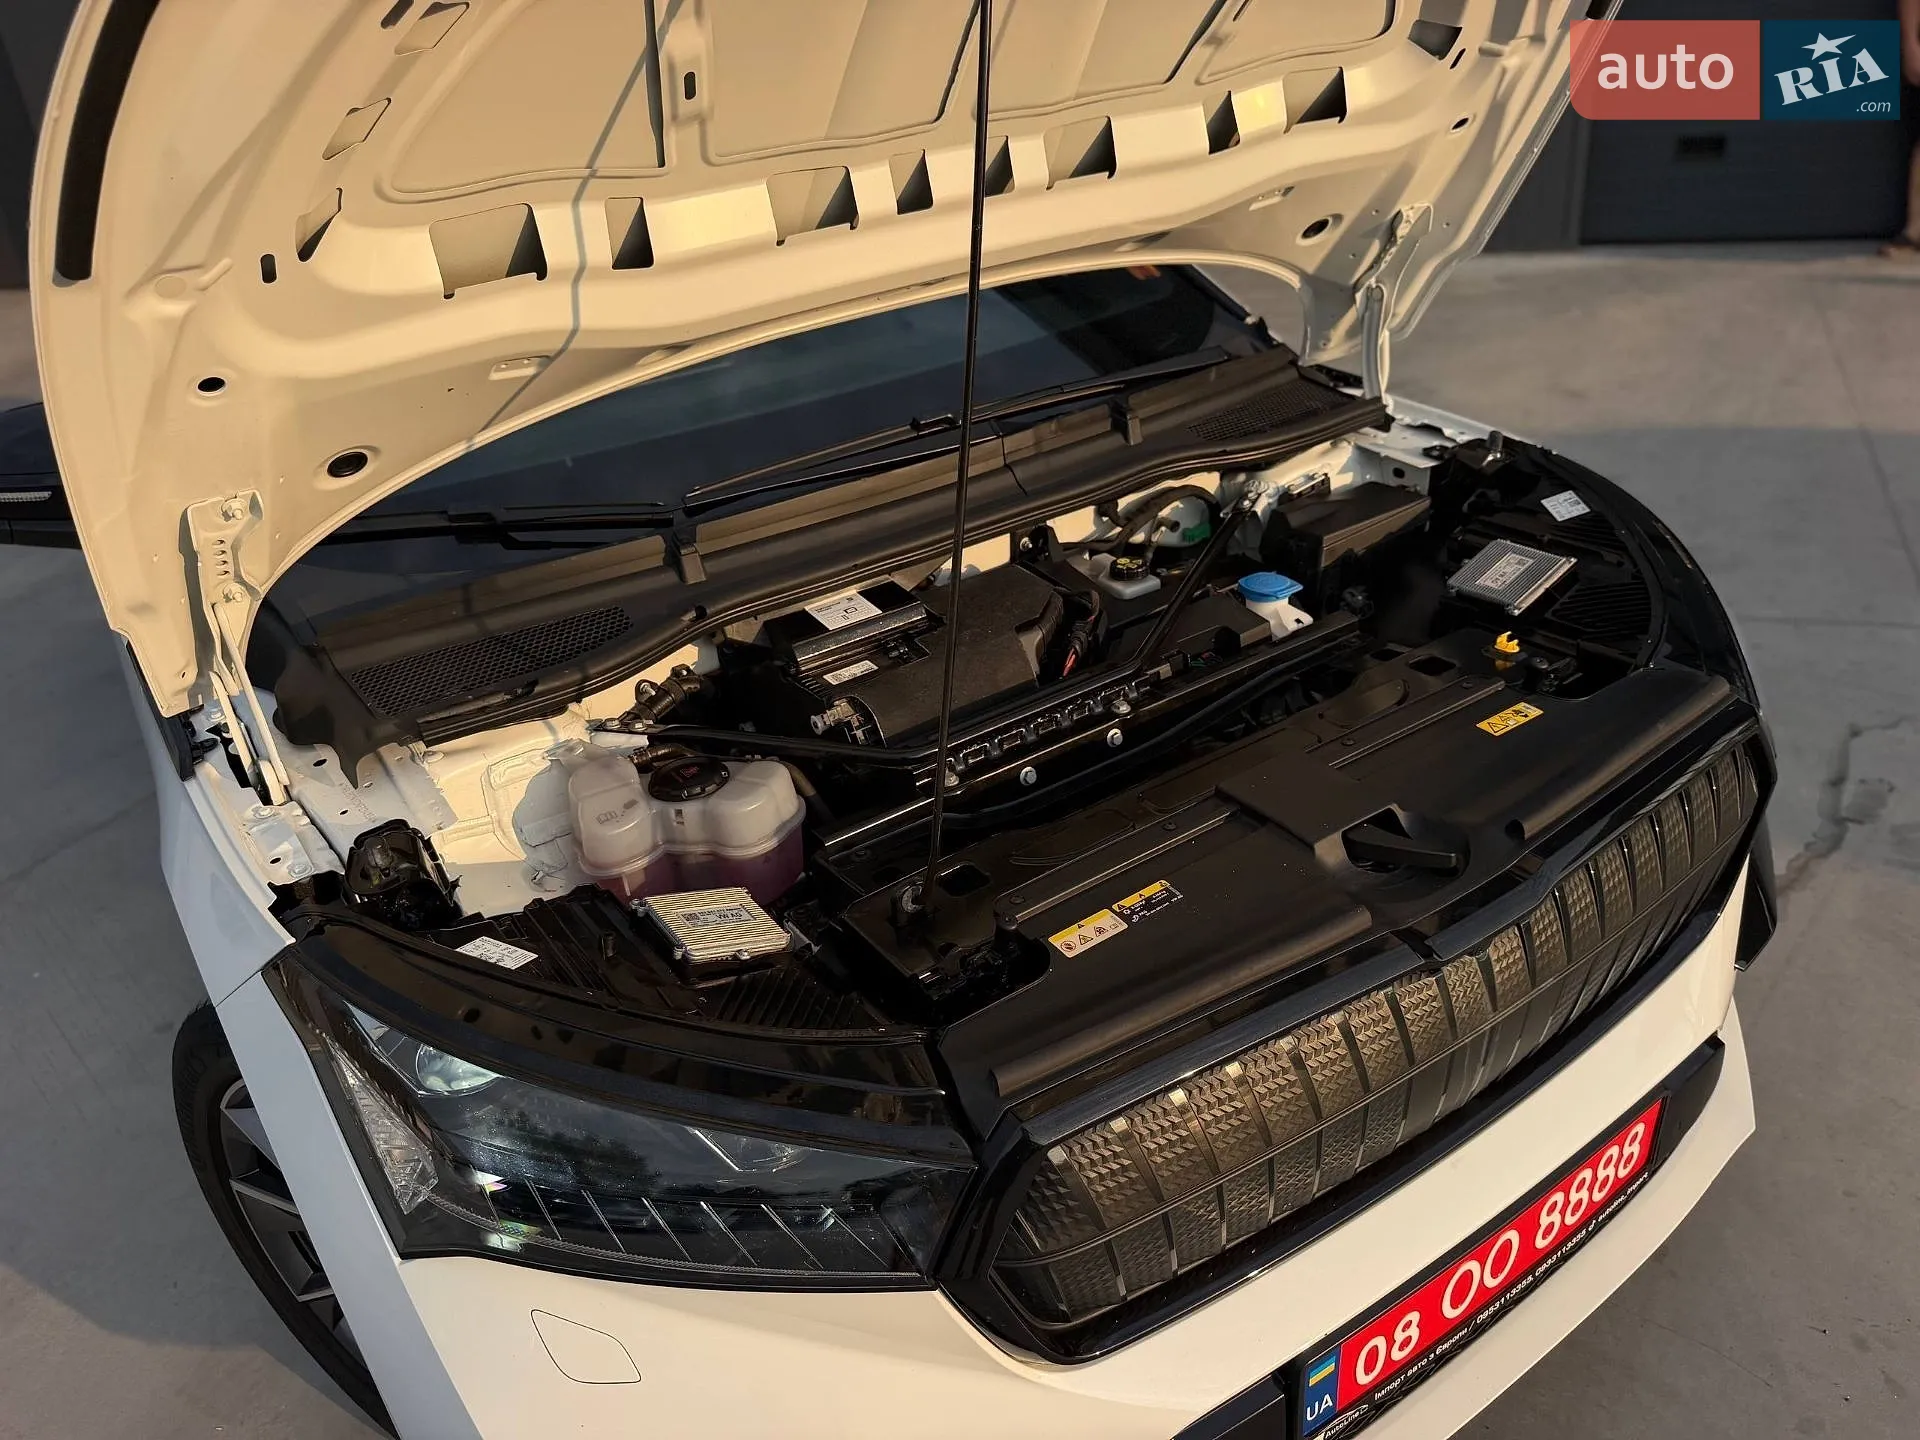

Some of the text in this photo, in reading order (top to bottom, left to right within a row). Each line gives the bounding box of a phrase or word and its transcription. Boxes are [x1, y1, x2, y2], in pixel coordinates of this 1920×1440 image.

[1354, 1310, 1421, 1386] 08
[1534, 1122, 1646, 1250] 8888
[1407, 1359, 1428, 1377] авто
[1306, 1393, 1333, 1421] UA
[1324, 1411, 1360, 1439] AutoLine
